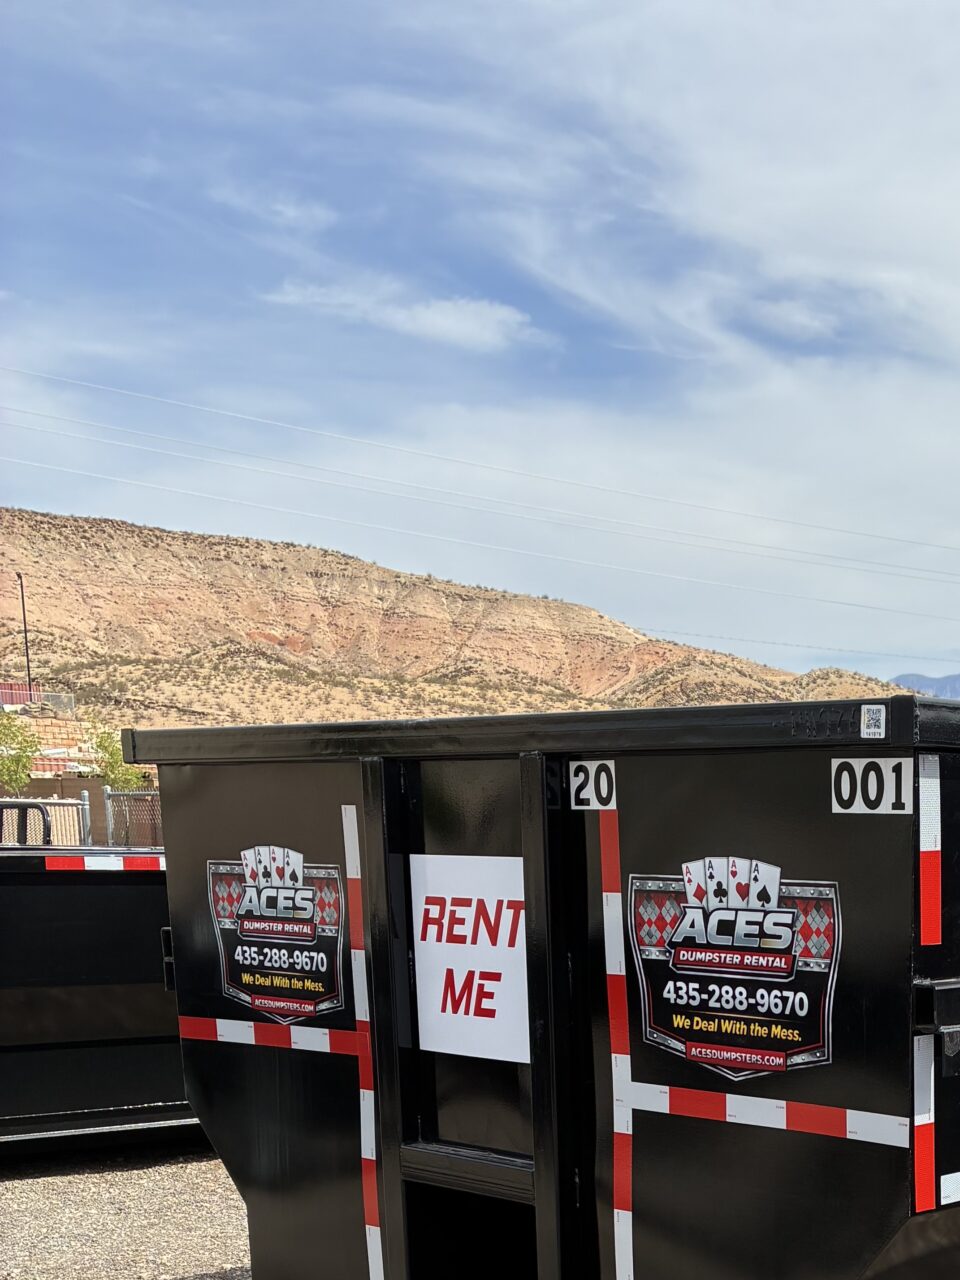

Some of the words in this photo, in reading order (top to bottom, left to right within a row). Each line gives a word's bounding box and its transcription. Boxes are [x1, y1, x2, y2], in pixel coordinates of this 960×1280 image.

[574, 763, 614, 806] 20
[833, 761, 906, 810] 001
[238, 887, 314, 918] ACES
[243, 921, 283, 932] DUMPSTER
[284, 924, 312, 934] RENTAL
[420, 896, 525, 948] RENT
[672, 908, 793, 949] ACES
[234, 945, 327, 972] 435-288-9670
[680, 951, 741, 965] DUMPSTER
[744, 954, 787, 969] RENTAL
[241, 972, 254, 985] We
[255, 974, 272, 986] Deal
[272, 976, 290, 989] With
[291, 978, 303, 990] the
[304, 979, 325, 992] Mess.
[440, 967, 502, 1019] ME
[254, 998, 314, 1012] ACESDUMPSTERS.COM
[663, 981, 809, 1017] 435-288-9670
[673, 1014, 691, 1029] We
[693, 1017, 718, 1032] Deal
[721, 1019, 747, 1036] With
[750, 1022, 768, 1037] the
[771, 1025, 802, 1041] Mess.
[691, 1048, 784, 1066] ACESDUMPSTERS.COM
